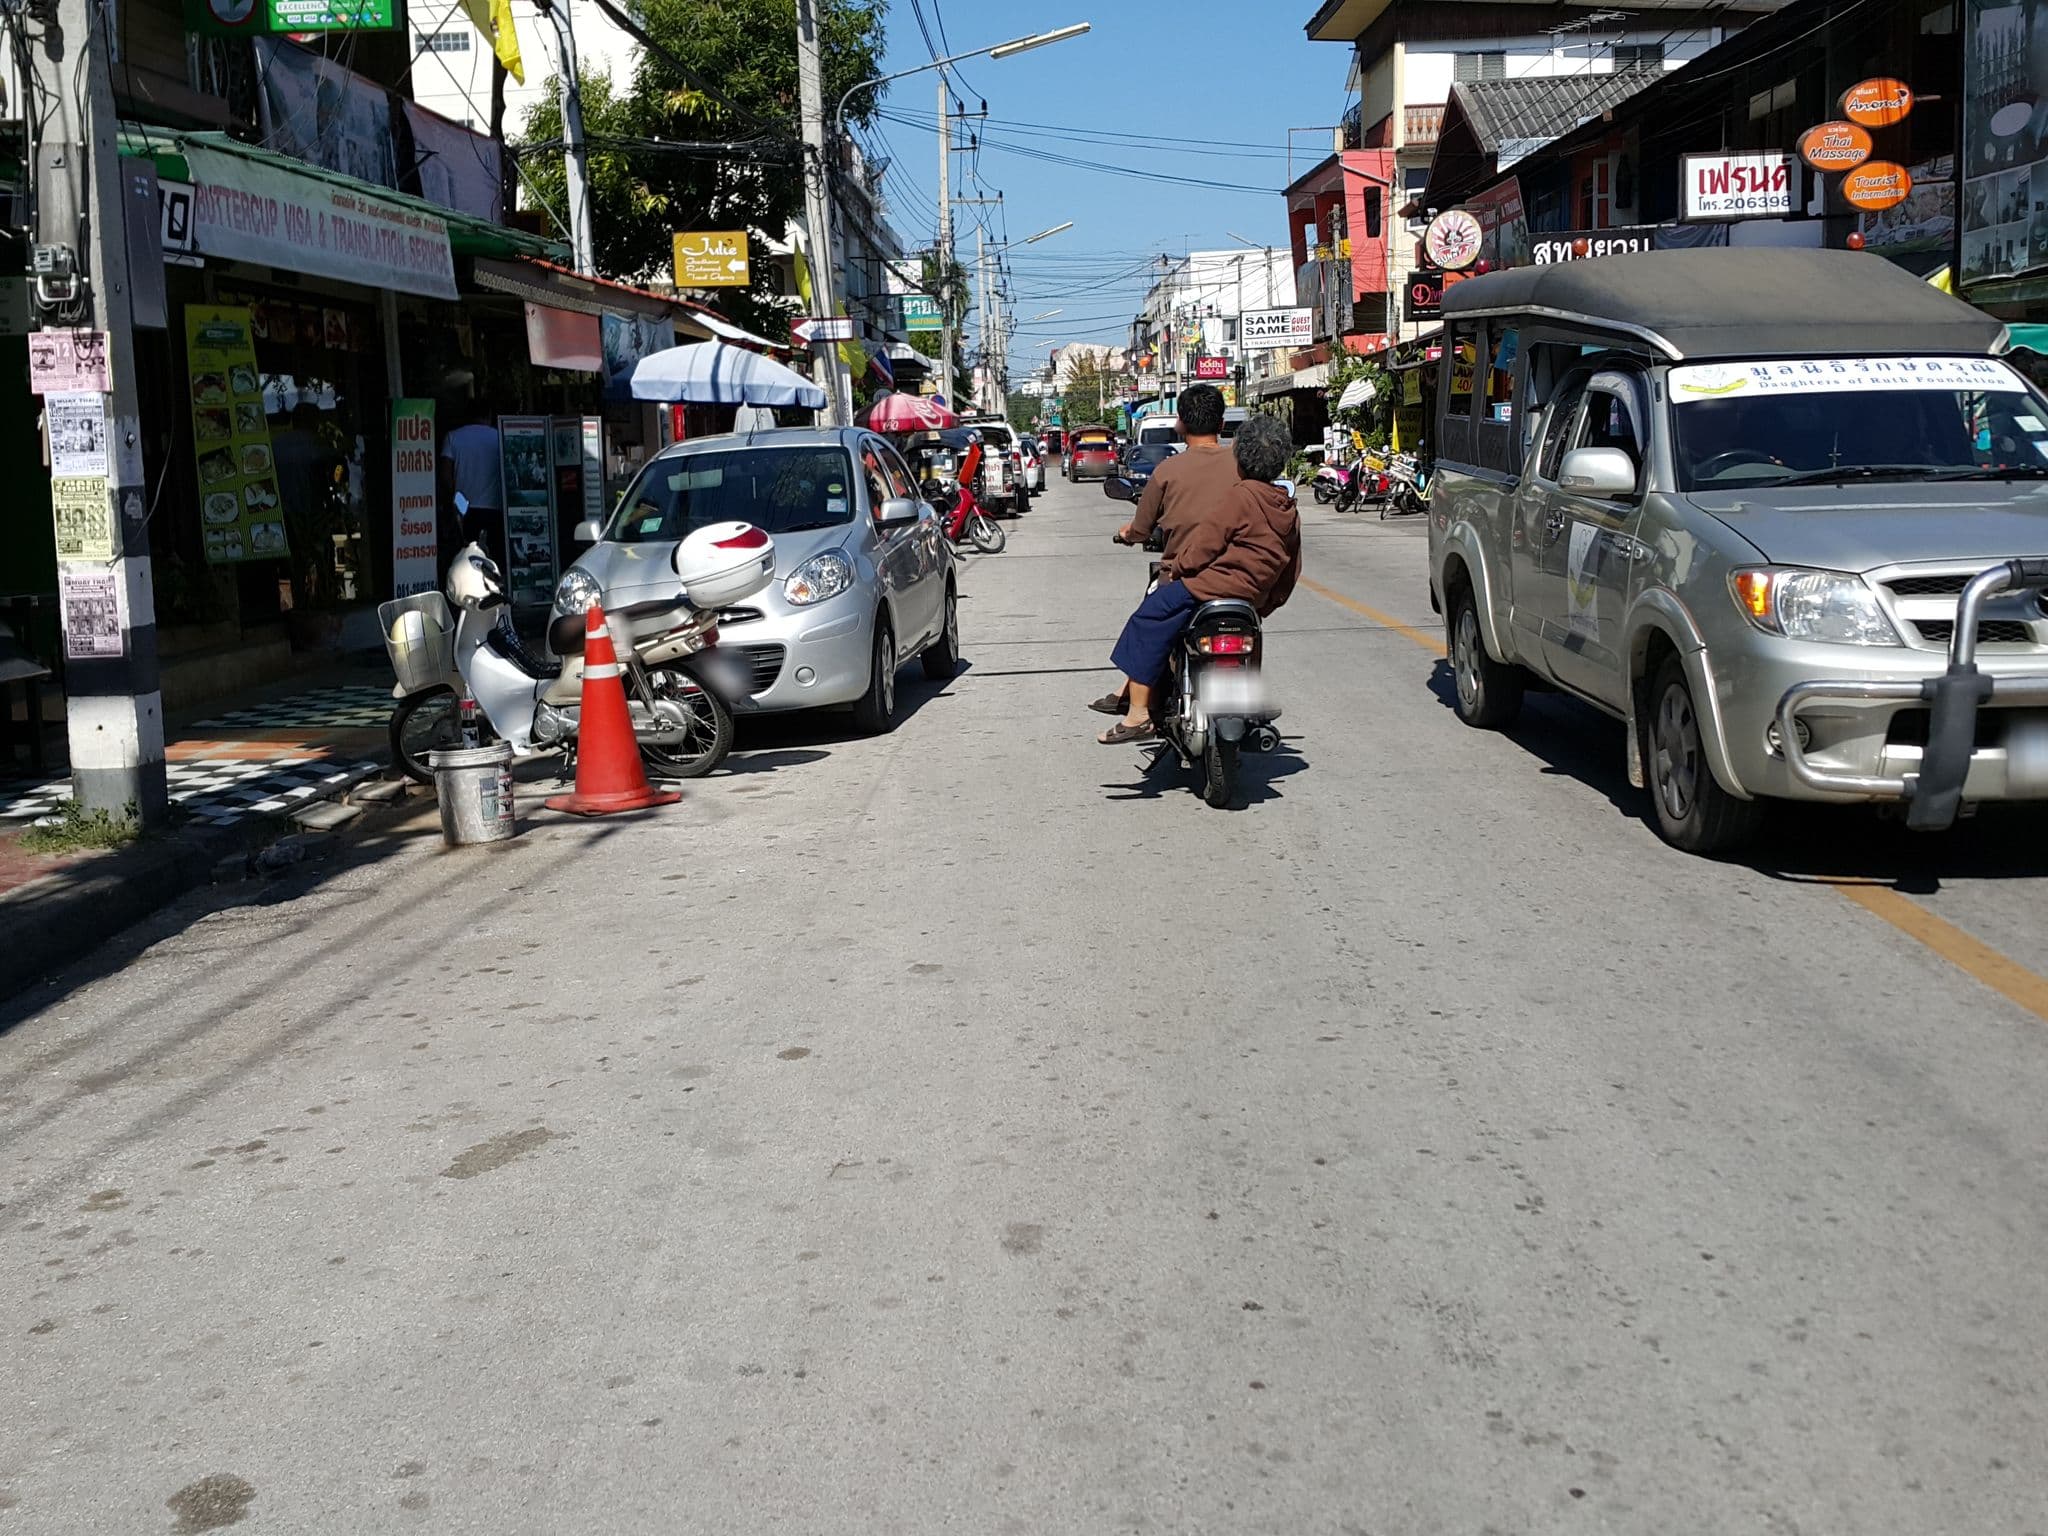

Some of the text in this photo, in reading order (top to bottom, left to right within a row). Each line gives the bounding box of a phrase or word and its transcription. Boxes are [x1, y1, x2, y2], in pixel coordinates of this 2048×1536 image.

[1848, 97, 1905, 112] Anoma
[1824, 135, 1852, 147] Thai
[1809, 148, 1866, 161] Massage
[1699, 157, 1792, 195] เฟรนด์
[1855, 173, 1900, 188] Tourist
[1852, 188, 1905, 199] Information
[196, 183, 279, 237] BUTTERCUP
[284, 201, 314, 246] VISA
[318, 211, 327, 249] &
[331, 214, 405, 267] TRANSLATION
[408, 235, 450, 276] SERVICE
[682, 237, 737, 256] Julie
[1245, 314, 1290, 325] SAME
[1291, 316, 1311, 325] GUEST
[1245, 325, 1290, 336] SAME
[1291, 325, 1311, 333] HOUSE
[1759, 376, 2005, 388] Daughters of Ruth Foundation
[397, 413, 431, 441] แปล
[396, 448, 433, 473] เอกสาร
